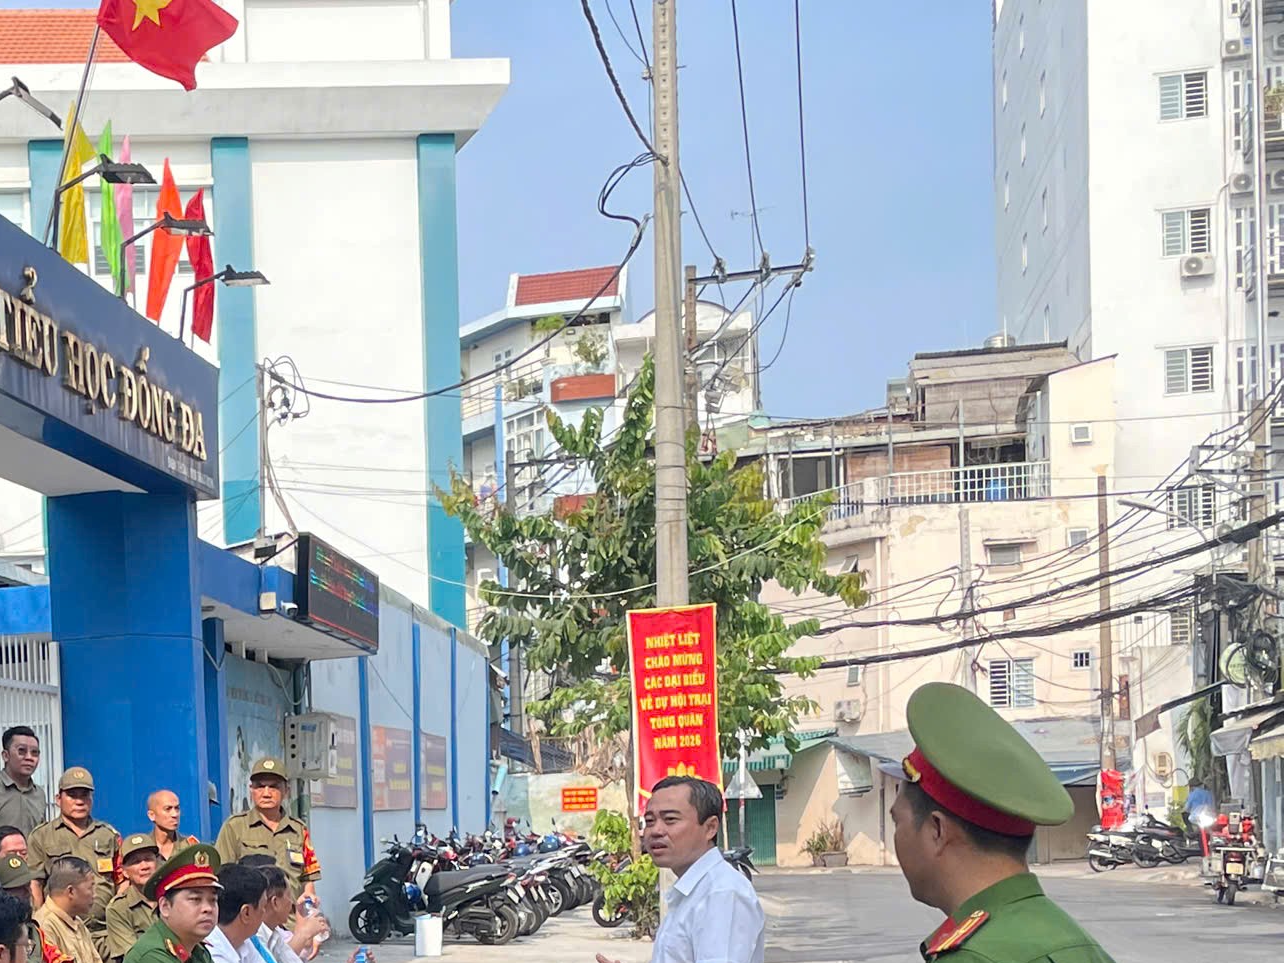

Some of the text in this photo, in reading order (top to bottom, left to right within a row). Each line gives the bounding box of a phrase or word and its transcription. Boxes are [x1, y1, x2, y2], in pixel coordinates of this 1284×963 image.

[62, 330, 116, 415] HỌC
[118, 346, 176, 442] ĐỐNG
[179, 401, 207, 461] ĐA
[645, 631, 700, 649] NHIỆT LIỆT
[645, 652, 703, 669] CHÀO MỪNG
[644, 675, 662, 690] CÁC
[683, 669, 705, 686] BIỂU
[640, 693, 653, 711] VỀ
[655, 695, 668, 711] DỰ
[670, 692, 687, 709] HỘI
[654, 734, 701, 749] NĂM 2026
